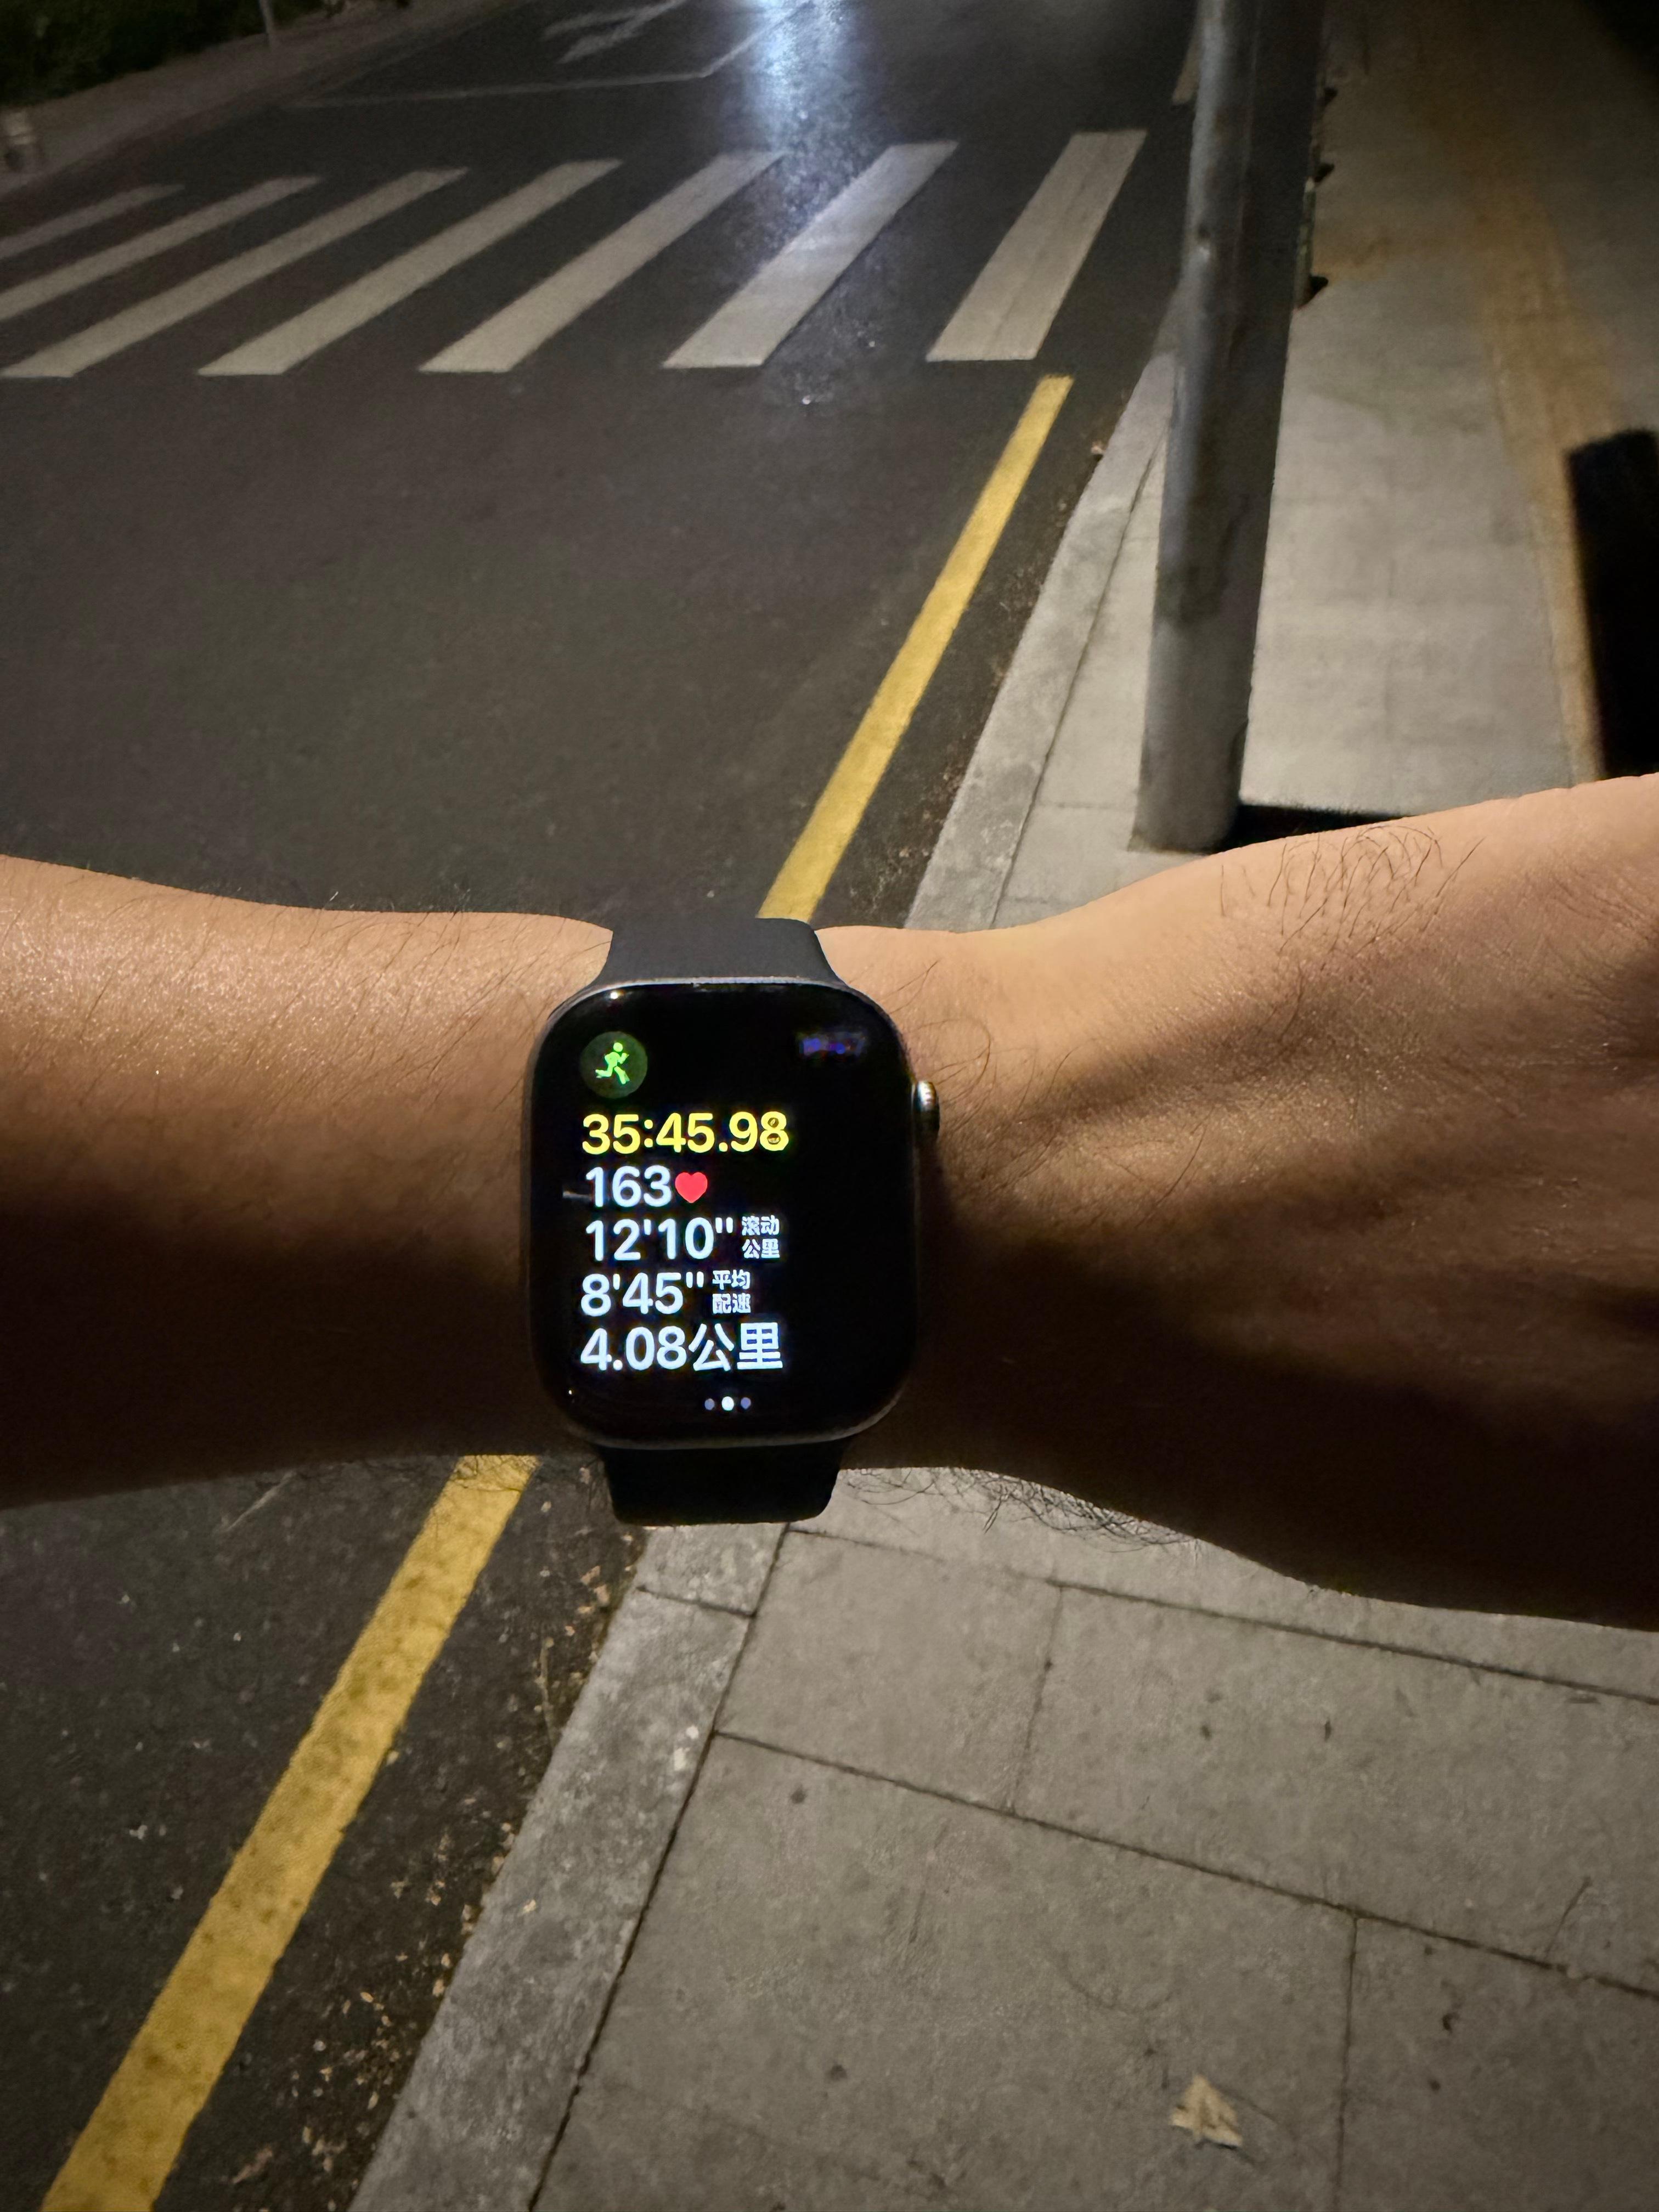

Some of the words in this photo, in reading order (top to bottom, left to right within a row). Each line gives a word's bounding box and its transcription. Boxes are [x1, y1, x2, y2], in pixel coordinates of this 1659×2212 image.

[582, 1110, 789, 1155] 35:45.98
[585, 1165, 673, 1207] 163
[741, 1214, 780, 1236] 滚动
[741, 1238, 781, 1259] 公里
[712, 1269, 751, 1290] 平均
[712, 1293, 752, 1314] 配速
[580, 1322, 783, 1372] 4.08公里
